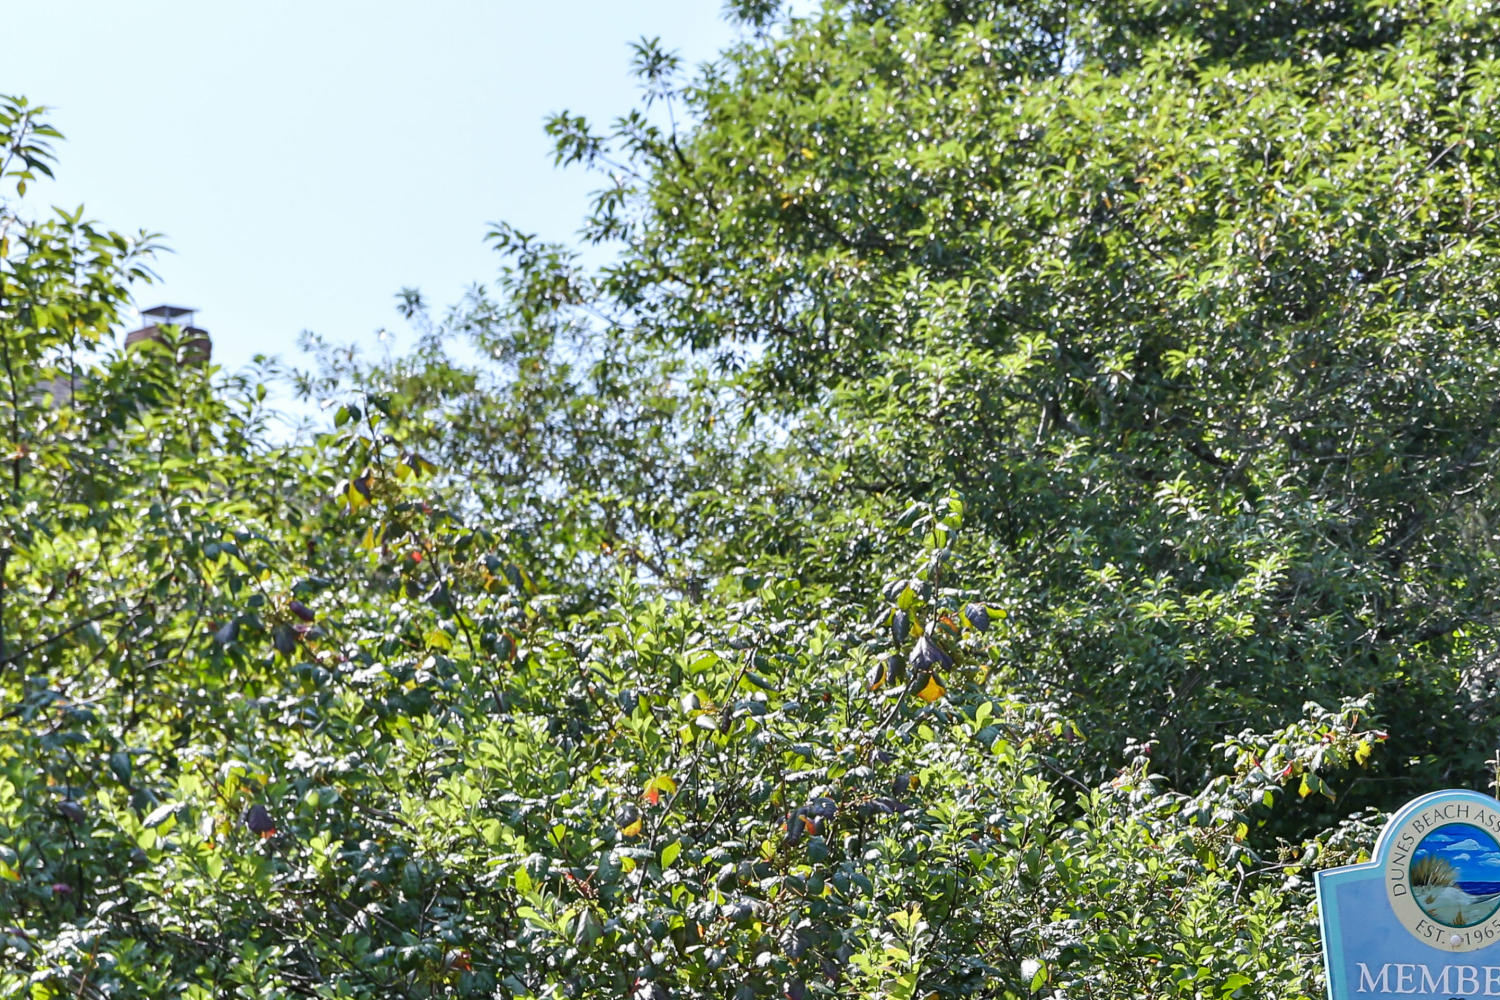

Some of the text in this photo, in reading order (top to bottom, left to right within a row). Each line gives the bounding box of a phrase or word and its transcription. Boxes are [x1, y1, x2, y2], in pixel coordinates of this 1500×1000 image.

[1391, 832, 1415, 897] DUNES
[1412, 804, 1470, 834] BEACH
[1415, 919, 1445, 944] EST.
